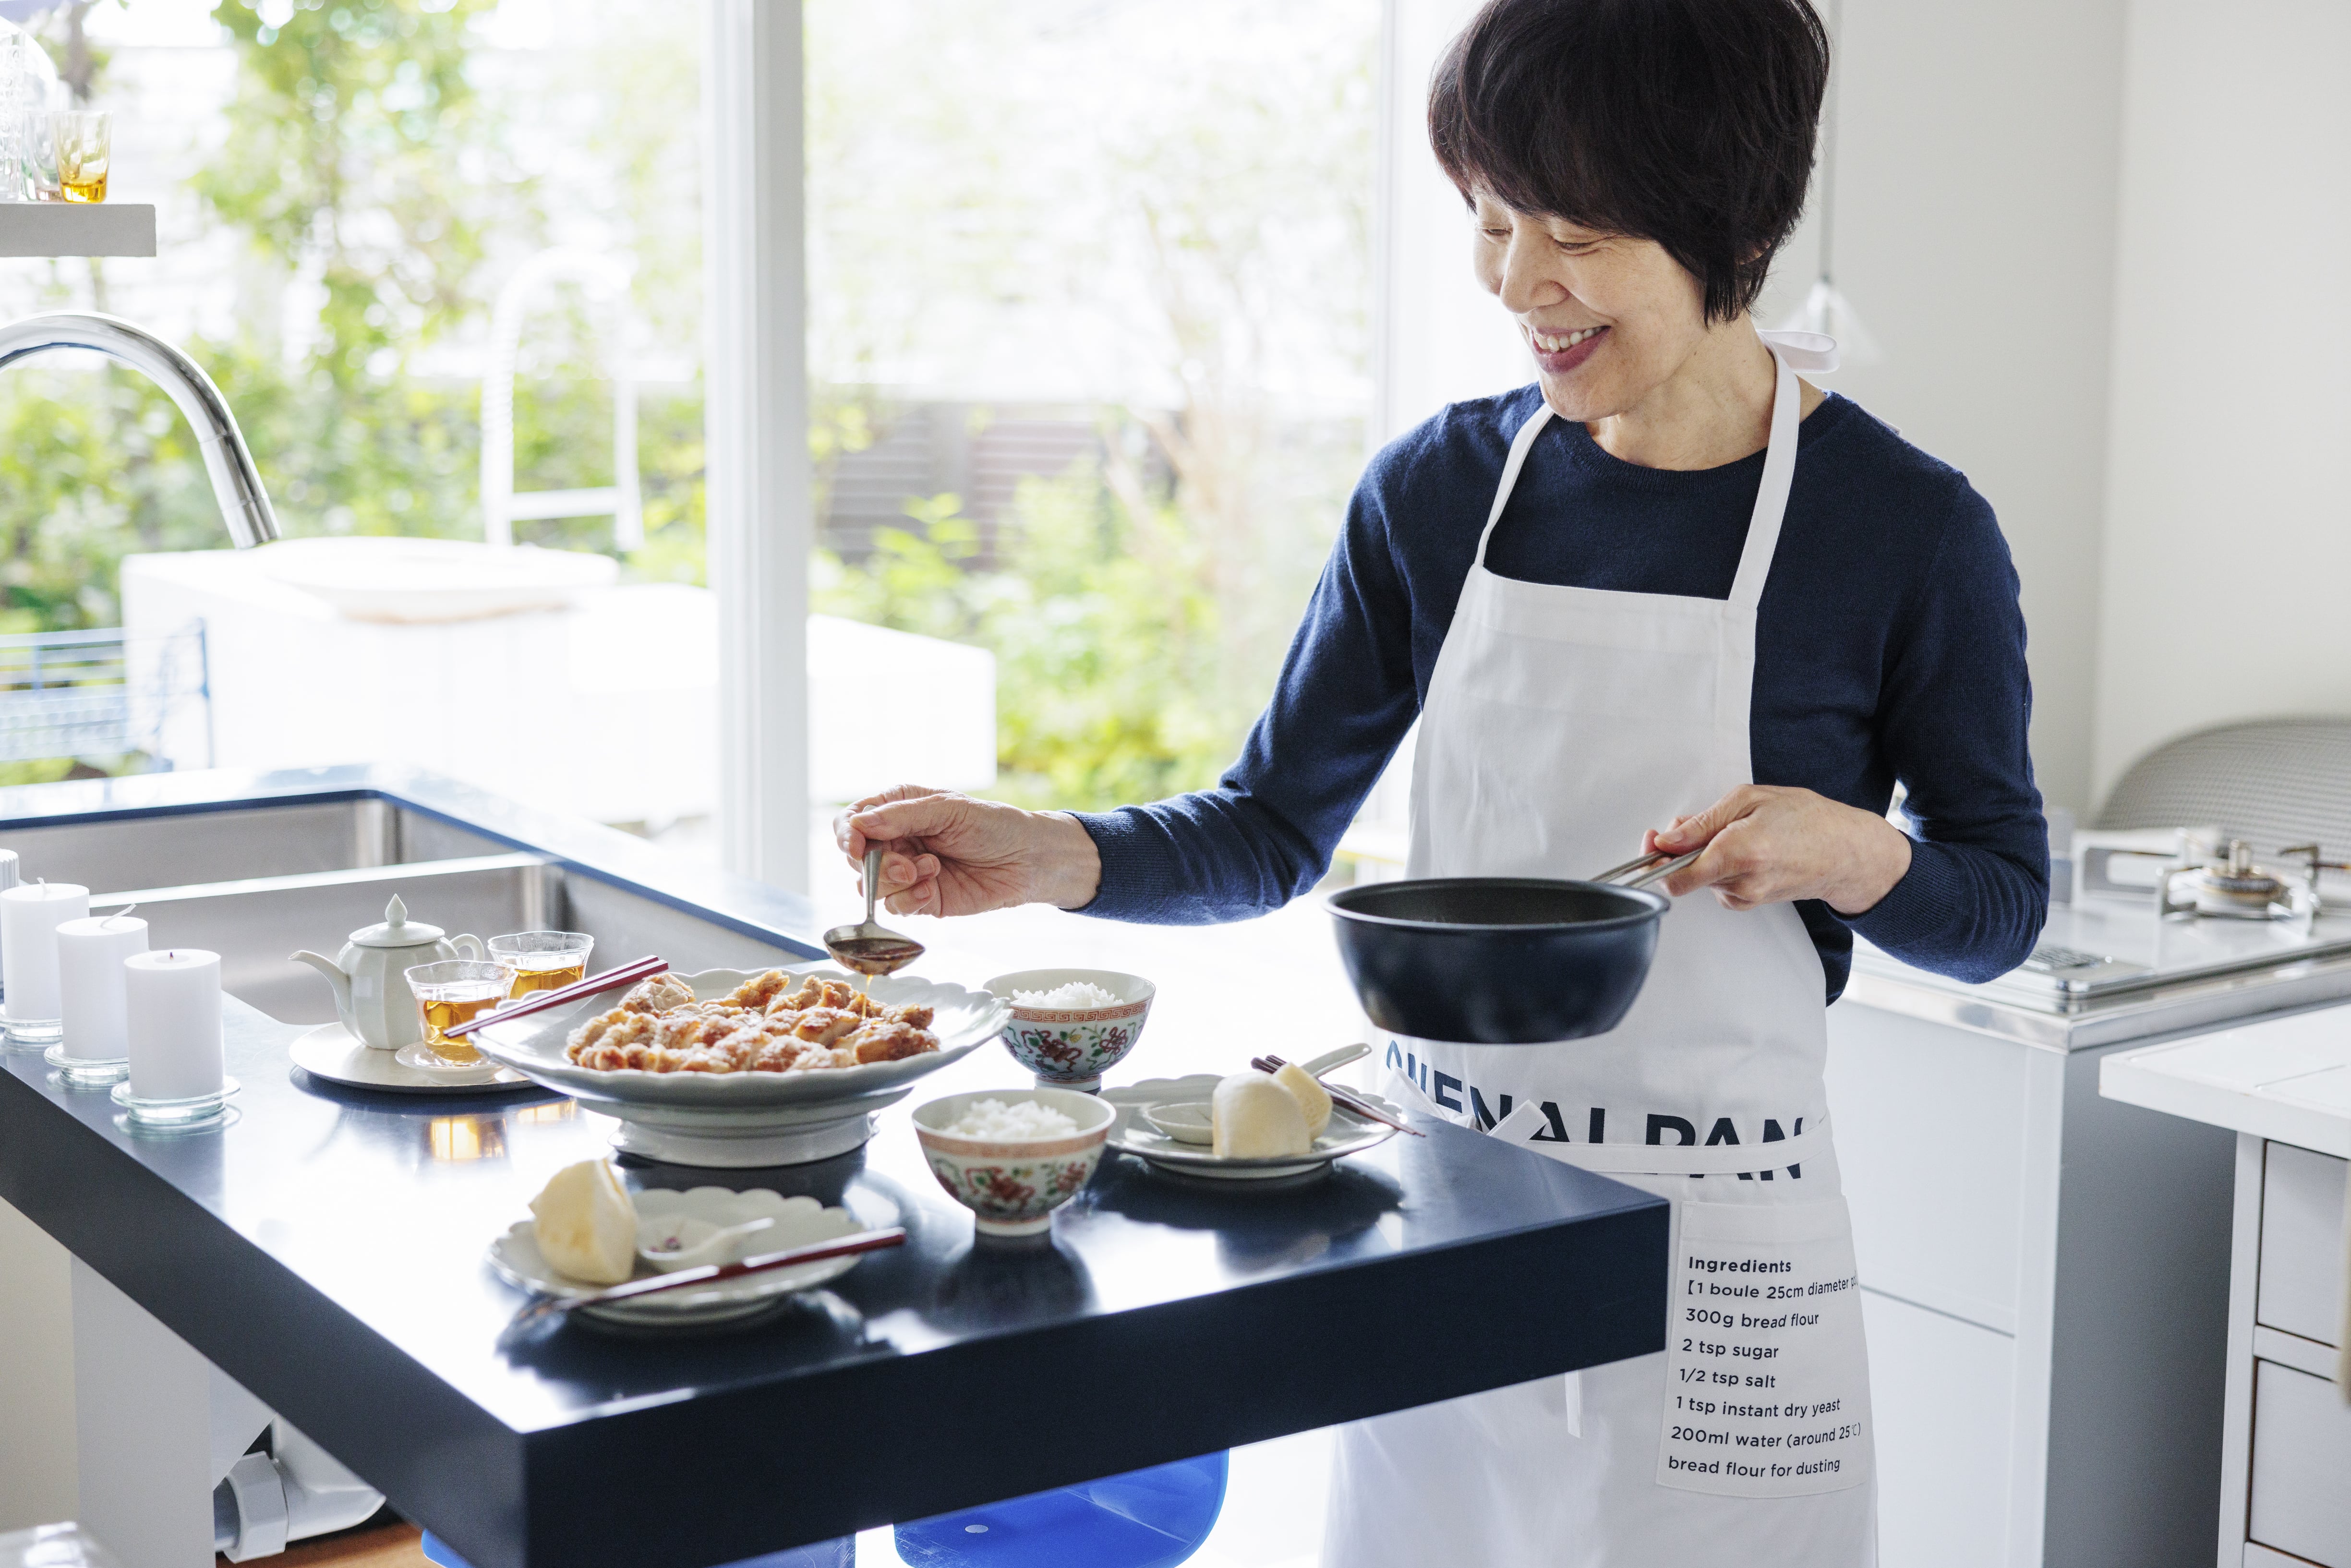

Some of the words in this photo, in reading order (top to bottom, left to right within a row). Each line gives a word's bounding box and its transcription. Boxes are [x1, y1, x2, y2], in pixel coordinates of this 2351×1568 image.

[1689, 1256, 1791, 1273] Ingredients
[1710, 1283, 1760, 1298] boule
[1766, 1286, 1803, 1299] 25cm
[1808, 1279, 1849, 1296] diameter
[1686, 1308, 1734, 1328] 300g
[1741, 1313, 1787, 1329] bread
[1791, 1313, 1819, 1327] flour
[1682, 1338, 1692, 1352] 2
[1699, 1340, 1726, 1357] tsp
[1732, 1346, 1779, 1360] sugar
[1680, 1368, 1706, 1383] 1/2
[1712, 1372, 1739, 1387] tsp
[1745, 1375, 1776, 1388] salt
[1676, 1396, 1682, 1409] 1
[1689, 1398, 1716, 1415] tsp
[1722, 1401, 1779, 1417] instant
[1784, 1403, 1808, 1418] dry
[1812, 1398, 1840, 1417] yeast
[1671, 1426, 1729, 1445] 200ml
[1736, 1435, 1782, 1447] water
[1786, 1428, 1835, 1448] (around
[1668, 1455, 1720, 1474] bread
[1726, 1461, 1766, 1477] flour
[1771, 1463, 1792, 1477] for
[1796, 1458, 1840, 1475] dusting
